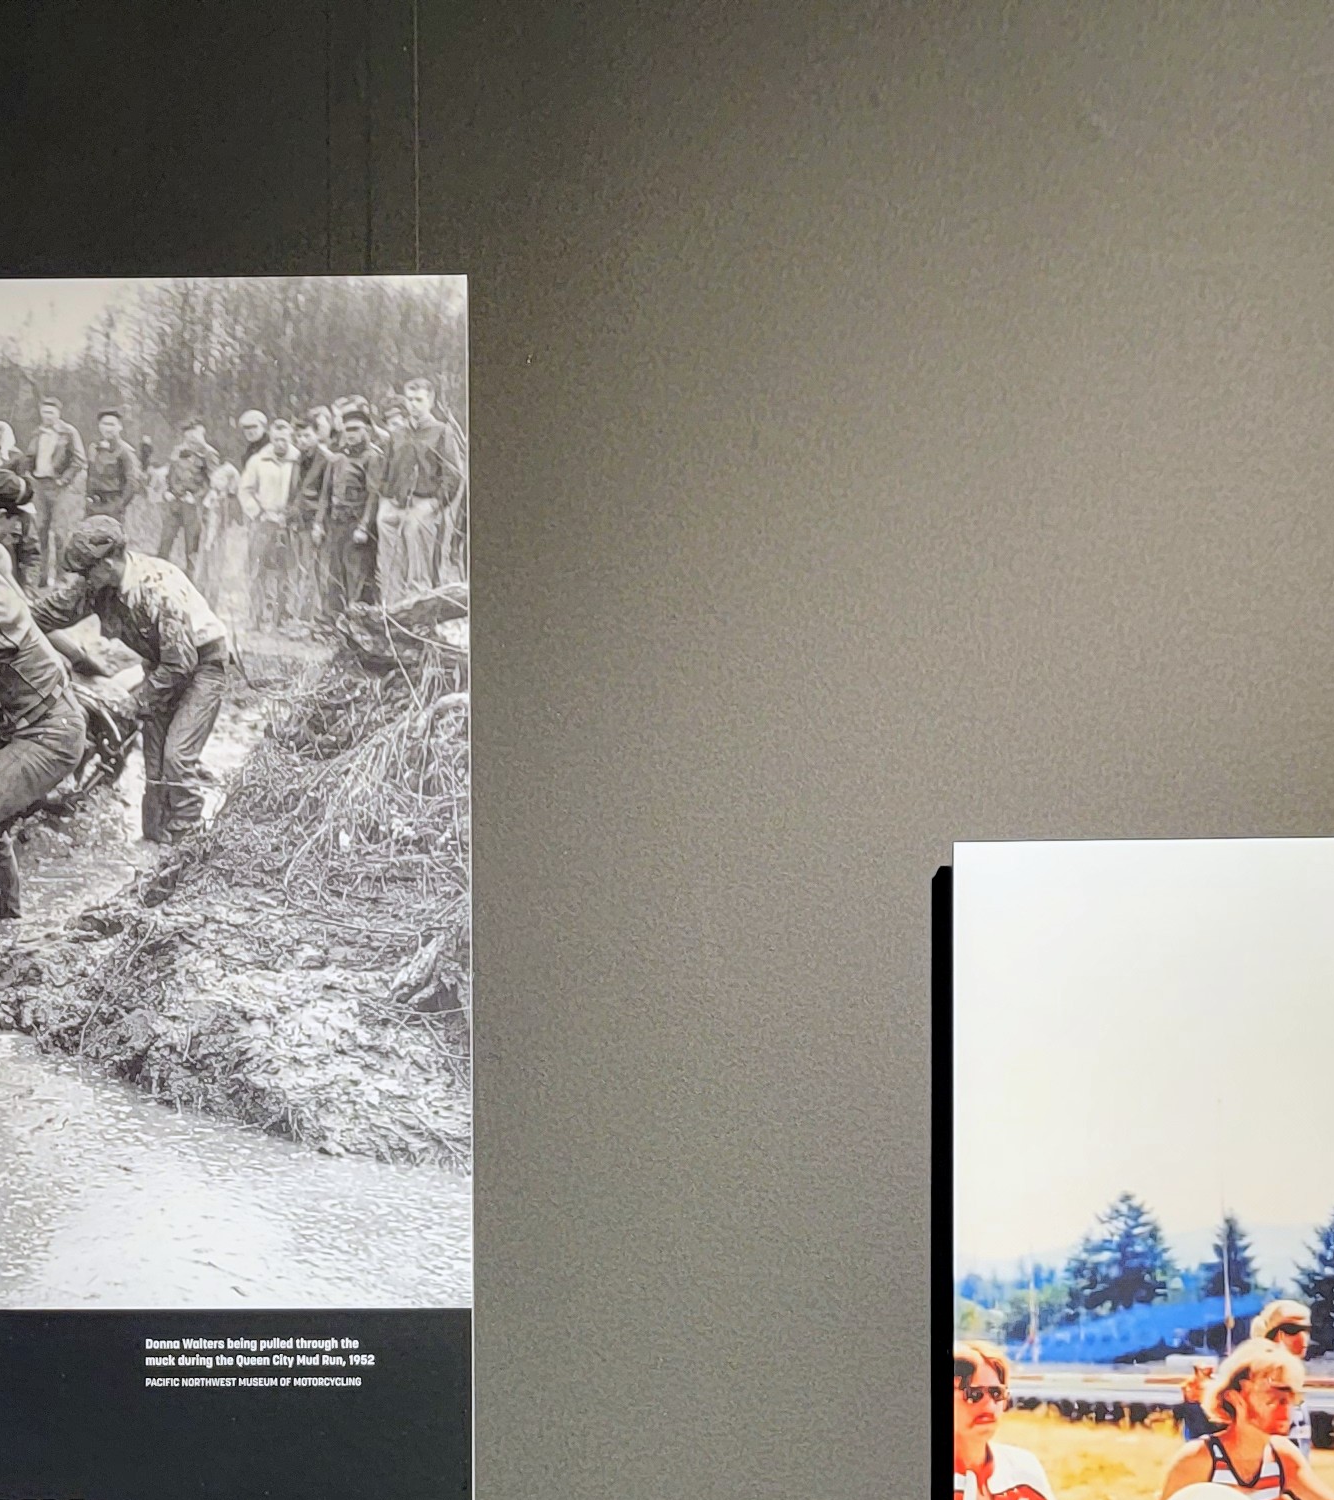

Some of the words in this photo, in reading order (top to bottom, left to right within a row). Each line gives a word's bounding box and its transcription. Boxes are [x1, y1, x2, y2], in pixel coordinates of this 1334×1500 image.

[144, 1337, 180, 1350] Donna
[181, 1337, 225, 1349] Walters
[226, 1336, 258, 1352] being
[259, 1336, 294, 1352] pulled
[295, 1336, 339, 1352] through
[339, 1336, 359, 1349] the
[144, 1353, 176, 1366] muck
[177, 1353, 213, 1369] during
[214, 1353, 234, 1366] the
[235, 1354, 270, 1368] Queen
[271, 1353, 295, 1368] City
[295, 1353, 320, 1366] Mud
[321, 1353, 347, 1367] Run,
[348, 1353, 375, 1366] 1952
[144, 1376, 180, 1387] PACIFIC
[181, 1376, 237, 1387] NORTHWEST
[237, 1376, 278, 1387] MUSEUM
[279, 1376, 292, 1387] OF
[292, 1376, 362, 1387] MOTORCYCLING
